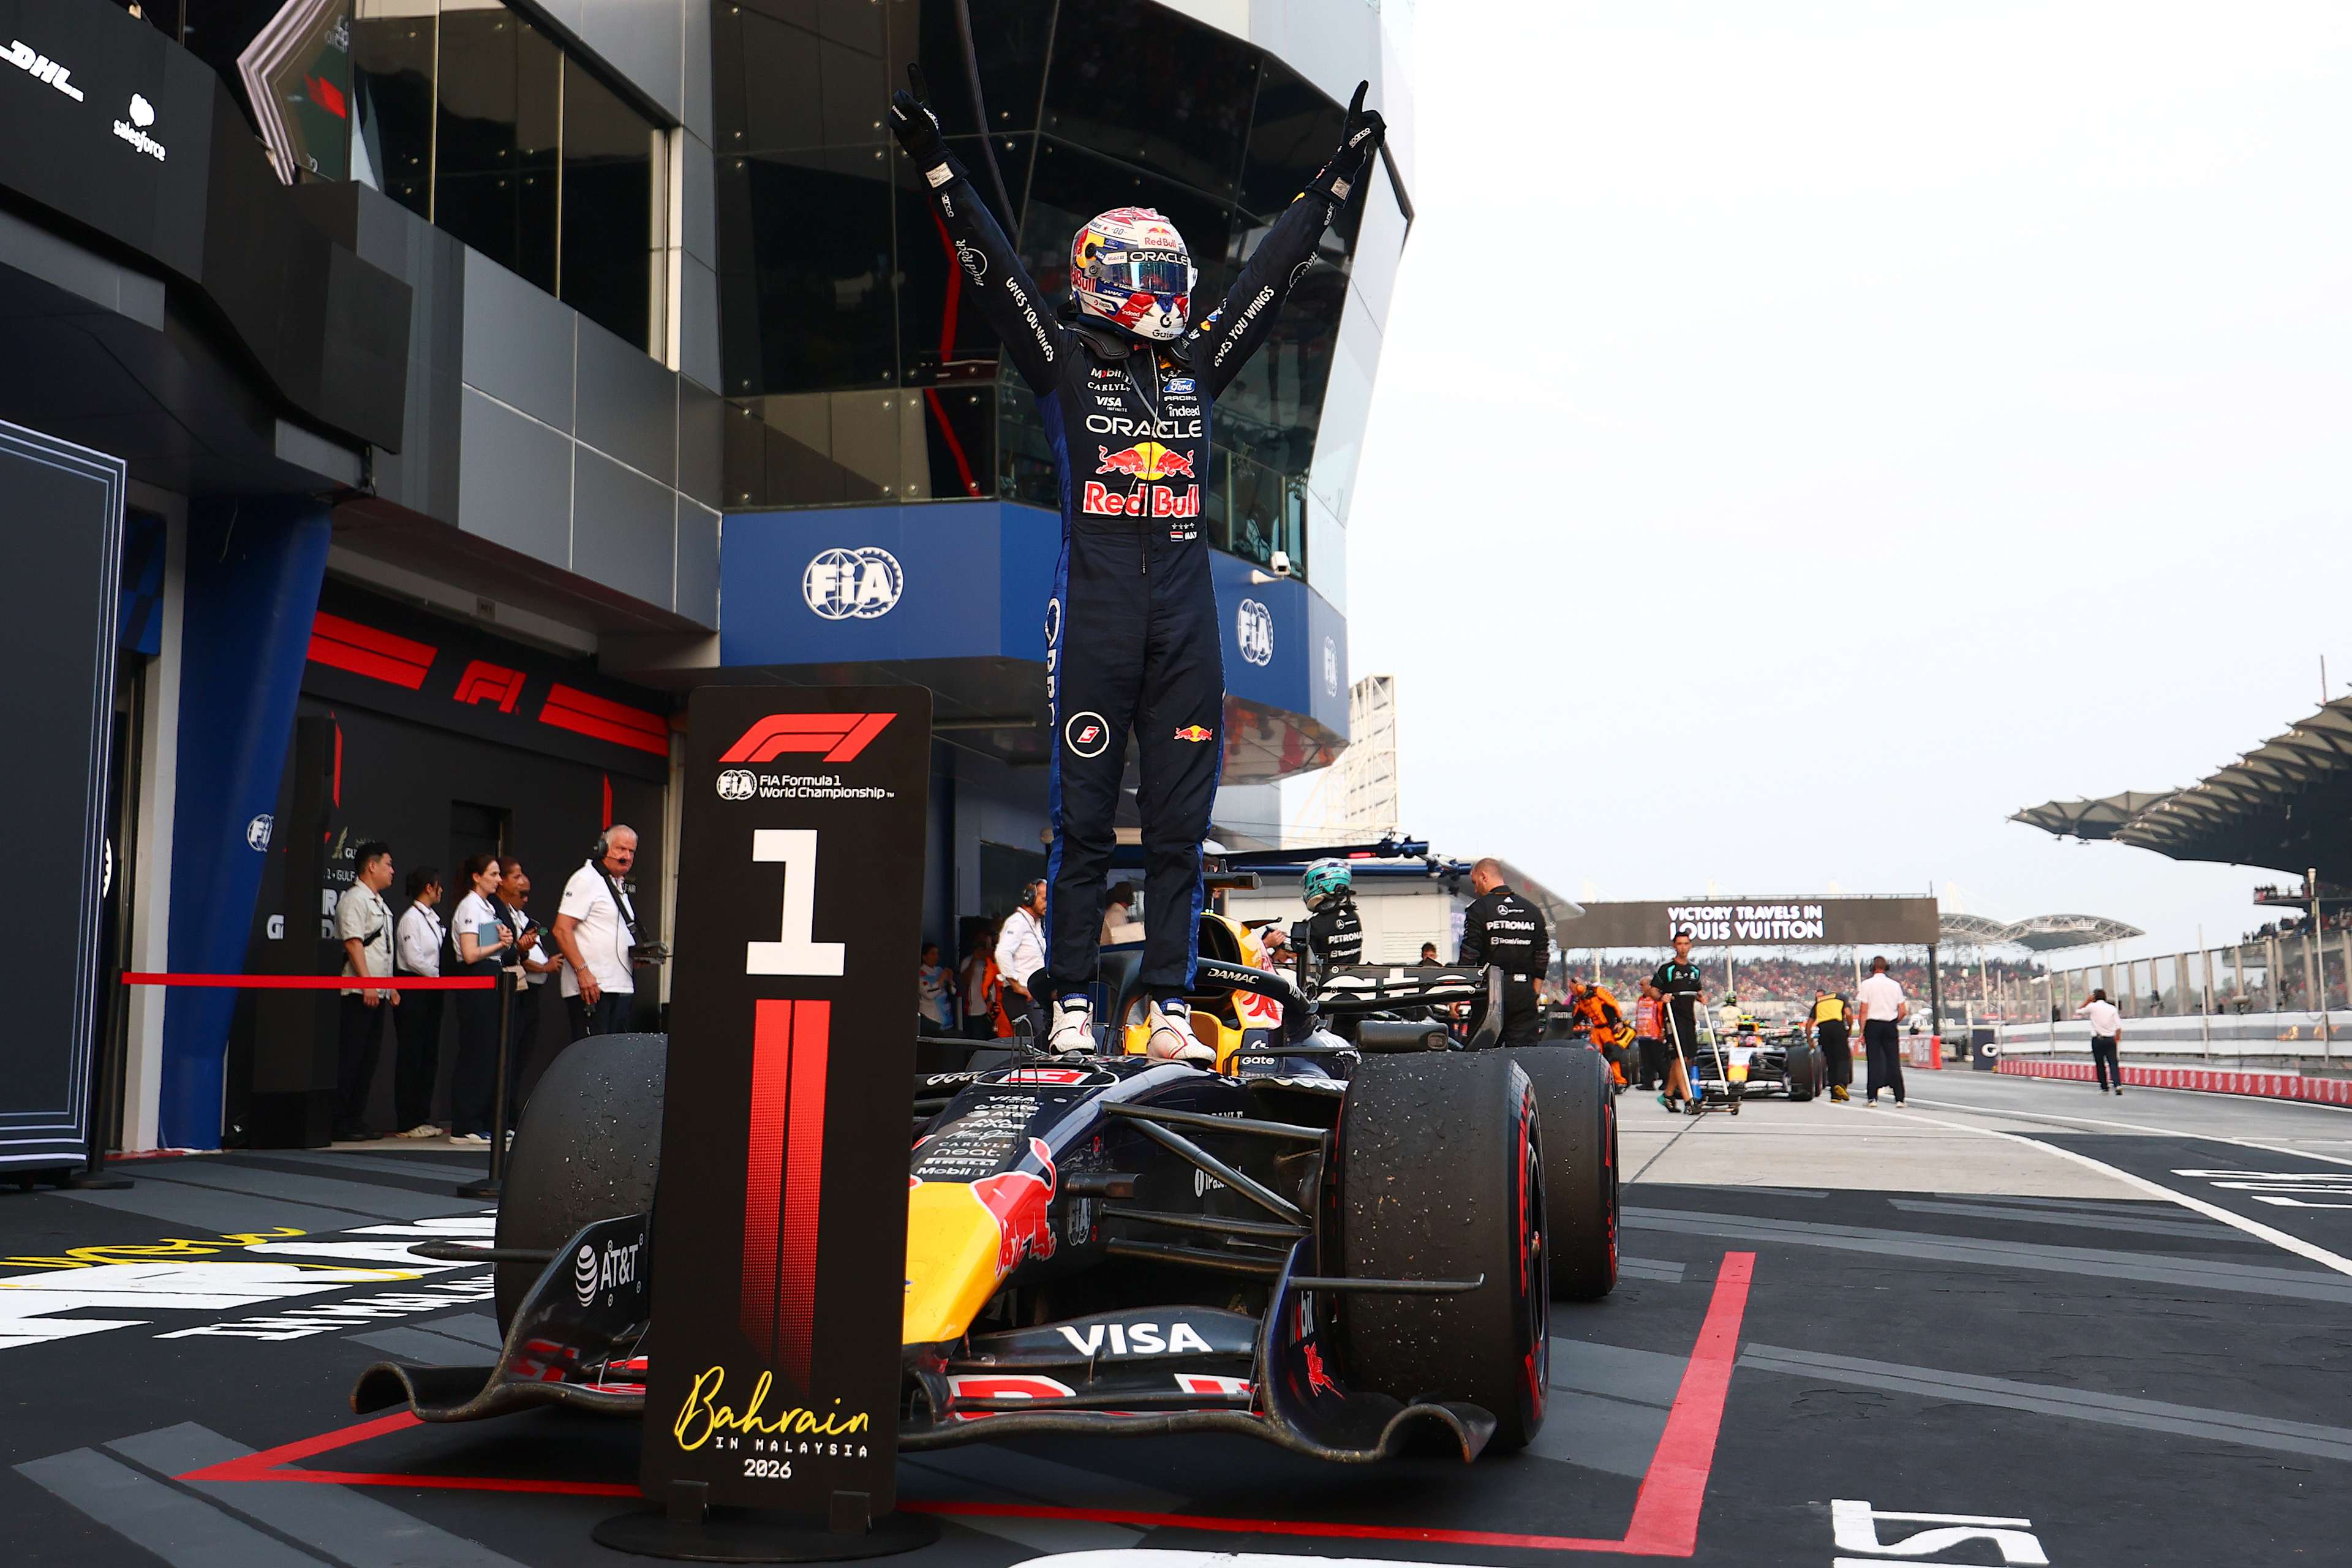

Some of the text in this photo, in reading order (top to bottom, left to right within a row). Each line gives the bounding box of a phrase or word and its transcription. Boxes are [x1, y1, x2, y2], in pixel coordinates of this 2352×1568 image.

[9, 39, 72, 96] DHL
[113, 119, 165, 161] salesforce
[1348, 127, 1371, 148] sparco
[1163, 238, 1177, 248] Bull
[1129, 252, 1188, 266] ORACLE
[1229, 320, 1248, 340] YOU
[1243, 285, 1275, 320] WINGS
[1022, 304, 1038, 329] YOU
[1036, 325, 1054, 363] WINGS
[1152, 330, 1175, 338] Gate
[1091, 368, 1121, 379] Mobil
[1167, 380, 1194, 392] Ford
[1095, 396, 1122, 407] VISA
[1167, 404, 1200, 417] indeed
[1086, 415, 1202, 439] ORACLE
[1083, 481, 1199, 518] Red Bull
[760, 775, 842, 786] FIA Formula 1
[760, 787, 796, 797] World
[797, 787, 885, 799] Championship
[337, 870, 356, 882] GULF
[746, 829, 845, 976] 1
[1667, 905, 1823, 921] VICTORY TRAVELS IN
[1486, 920, 1535, 931] PETRONAS
[1669, 921, 1825, 940] LOUIS VUITTON
[1328, 931, 1363, 944] PETRONA
[1207, 968, 1259, 984] DAMAC
[1241, 1055, 1275, 1065] Gate
[916, 1167, 972, 1175] Mobil
[600, 1243, 639, 1290] AT&T
[1057, 1322, 1213, 1356] VISA
[673, 1366, 869, 1451] Bahrain
[715, 1436, 868, 1458] IN MALAYSIA
[744, 1458, 792, 1479] 2026
